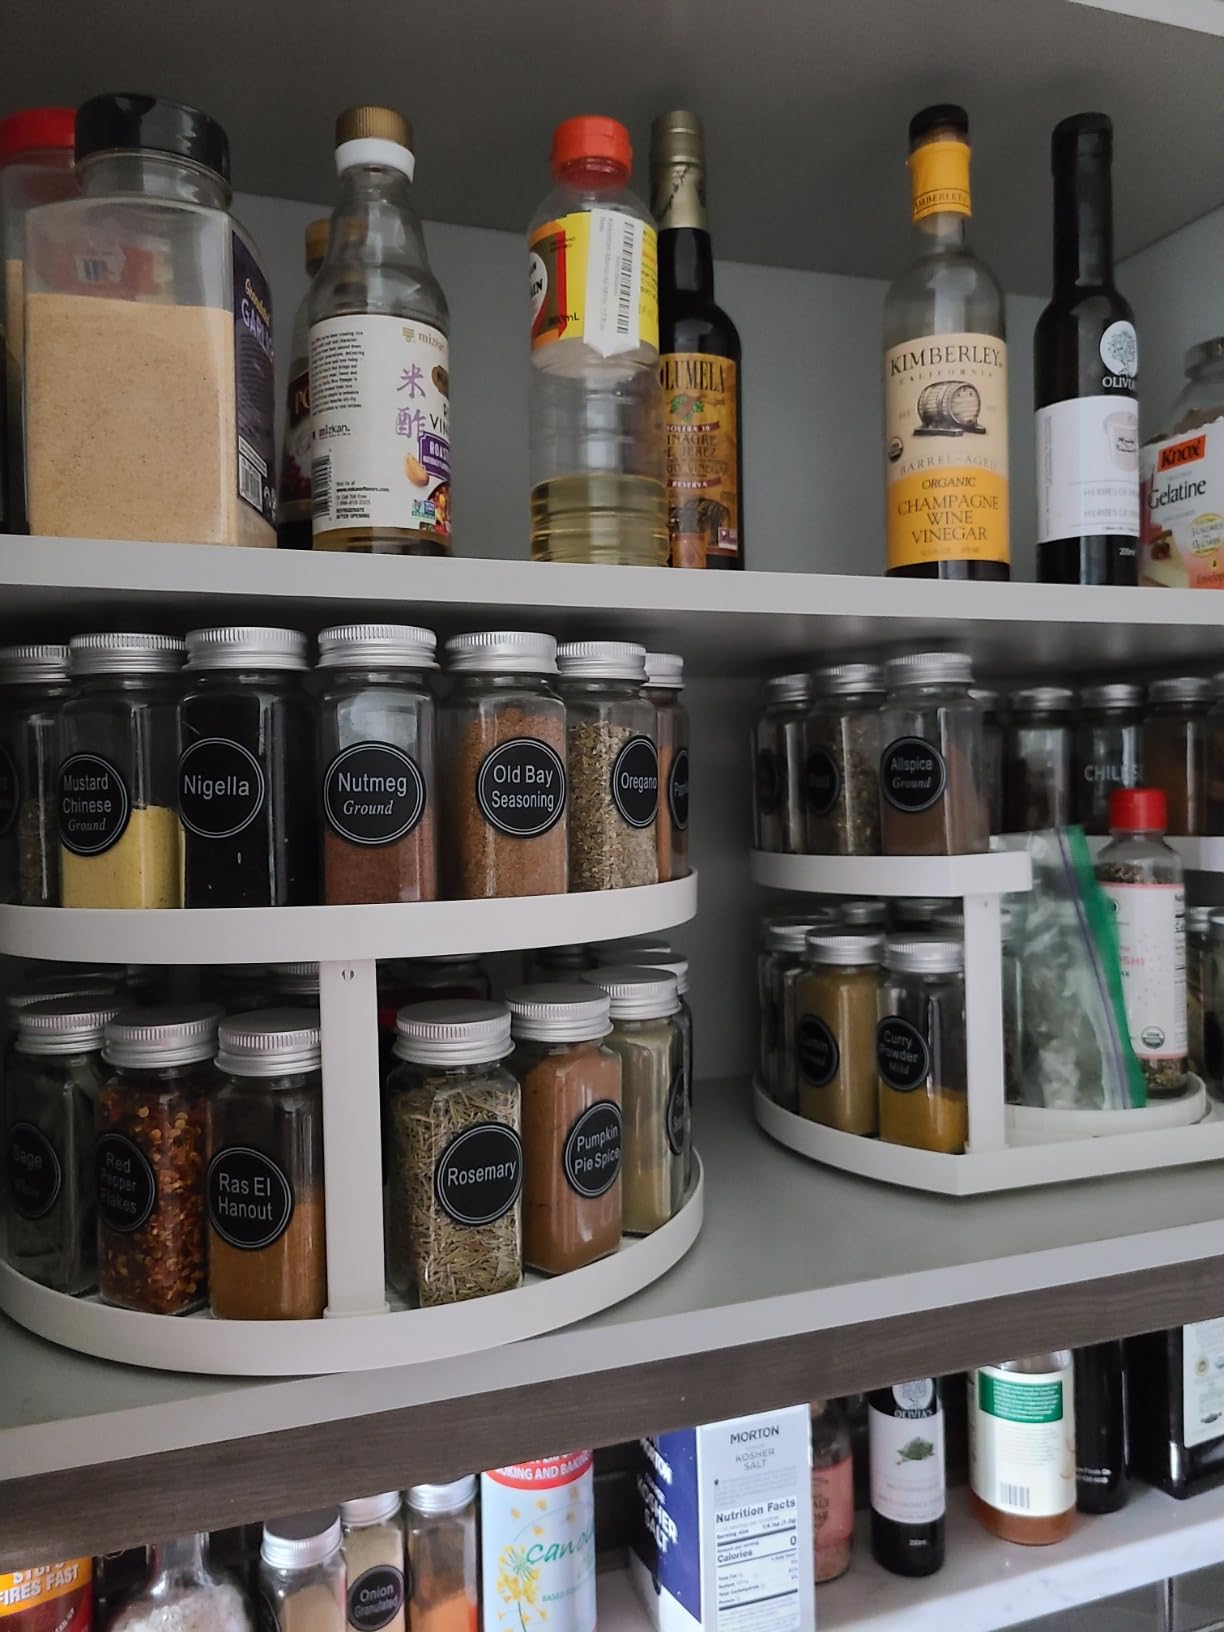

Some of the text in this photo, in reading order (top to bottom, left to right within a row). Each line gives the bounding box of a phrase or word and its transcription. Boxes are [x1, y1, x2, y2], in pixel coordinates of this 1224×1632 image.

[890, 345, 1001, 377] KIMBERLEY
[1161, 444, 1201, 468] Knox
[921, 477, 976, 490] ORGANIC
[1148, 479, 1207, 510] Gelatine
[897, 495, 1001, 516] CHAMPAGNE
[927, 511, 974, 526] WINE
[911, 527, 987, 545] VINEGAR
[890, 756, 934, 774] Allspice
[63, 773, 109, 791] Mustard
[338, 772, 407, 797] Nutmeg
[493, 764, 553, 788] Old Bay
[620, 771, 657, 793] Oregano
[892, 776, 932, 790] Ground
[184, 775, 250, 800] Nigella
[62, 797, 112, 814] Chinese
[343, 799, 394, 815] Ground
[491, 790, 554, 812] Seasoning
[68, 818, 106, 831] Ground
[883, 1029, 912, 1048] Curry
[879, 1043, 918, 1064] Powder
[577, 1124, 619, 1153] Pumpkin
[13, 1143, 42, 1171] Sage
[105, 1151, 131, 1174] Red
[574, 1146, 620, 1175] Pie Spice
[101, 1167, 137, 1193] Pepper
[447, 1158, 517, 1187] Rosemary
[219, 1172, 271, 1197] Ras El
[101, 1186, 137, 1214] Flakes
[218, 1195, 273, 1221] Hanout
[729, 1425, 780, 1445] MORTON
[735, 1447, 776, 1463] KOSHER
[744, 1459, 766, 1471] SALT
[534, 1465, 559, 1480] AND
[716, 1506, 763, 1524] Nutrition
[767, 1499, 796, 1513] Facts
[789, 1535, 797, 1546] 0
[717, 1549, 753, 1564] Calories
[45, 1563, 79, 1592] FAST
[360, 1583, 394, 1603] Onion
